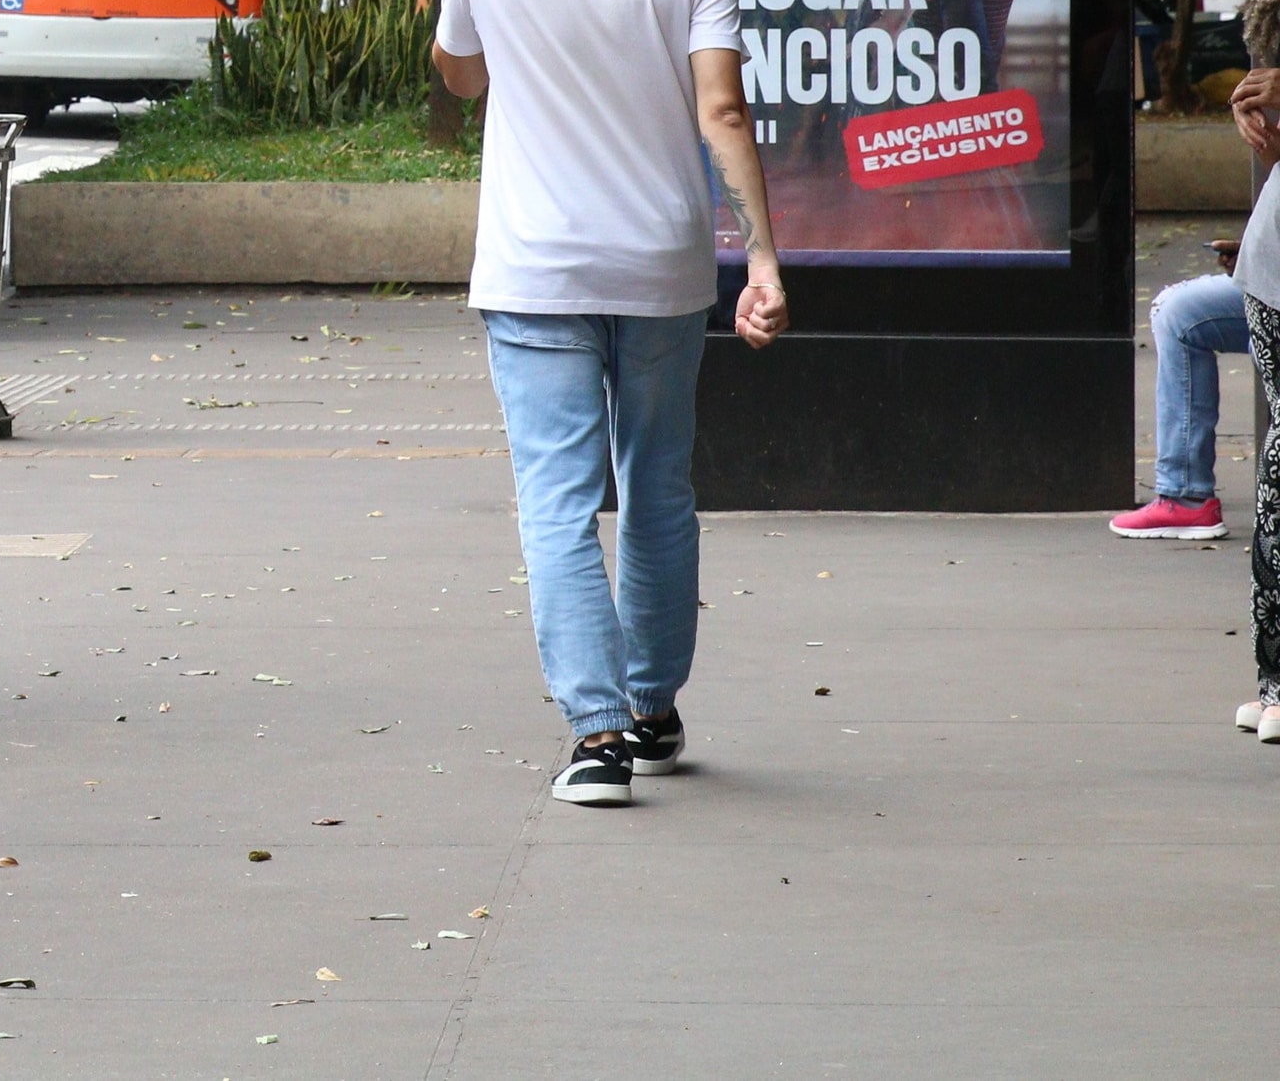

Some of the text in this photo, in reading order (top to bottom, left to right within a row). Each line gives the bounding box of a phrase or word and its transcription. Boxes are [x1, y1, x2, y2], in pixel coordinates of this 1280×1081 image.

[741, 26, 982, 106] NCIOSO
[857, 108, 1024, 153] LANÇAMENTO
[863, 129, 1029, 173] EXCLUSIVO
